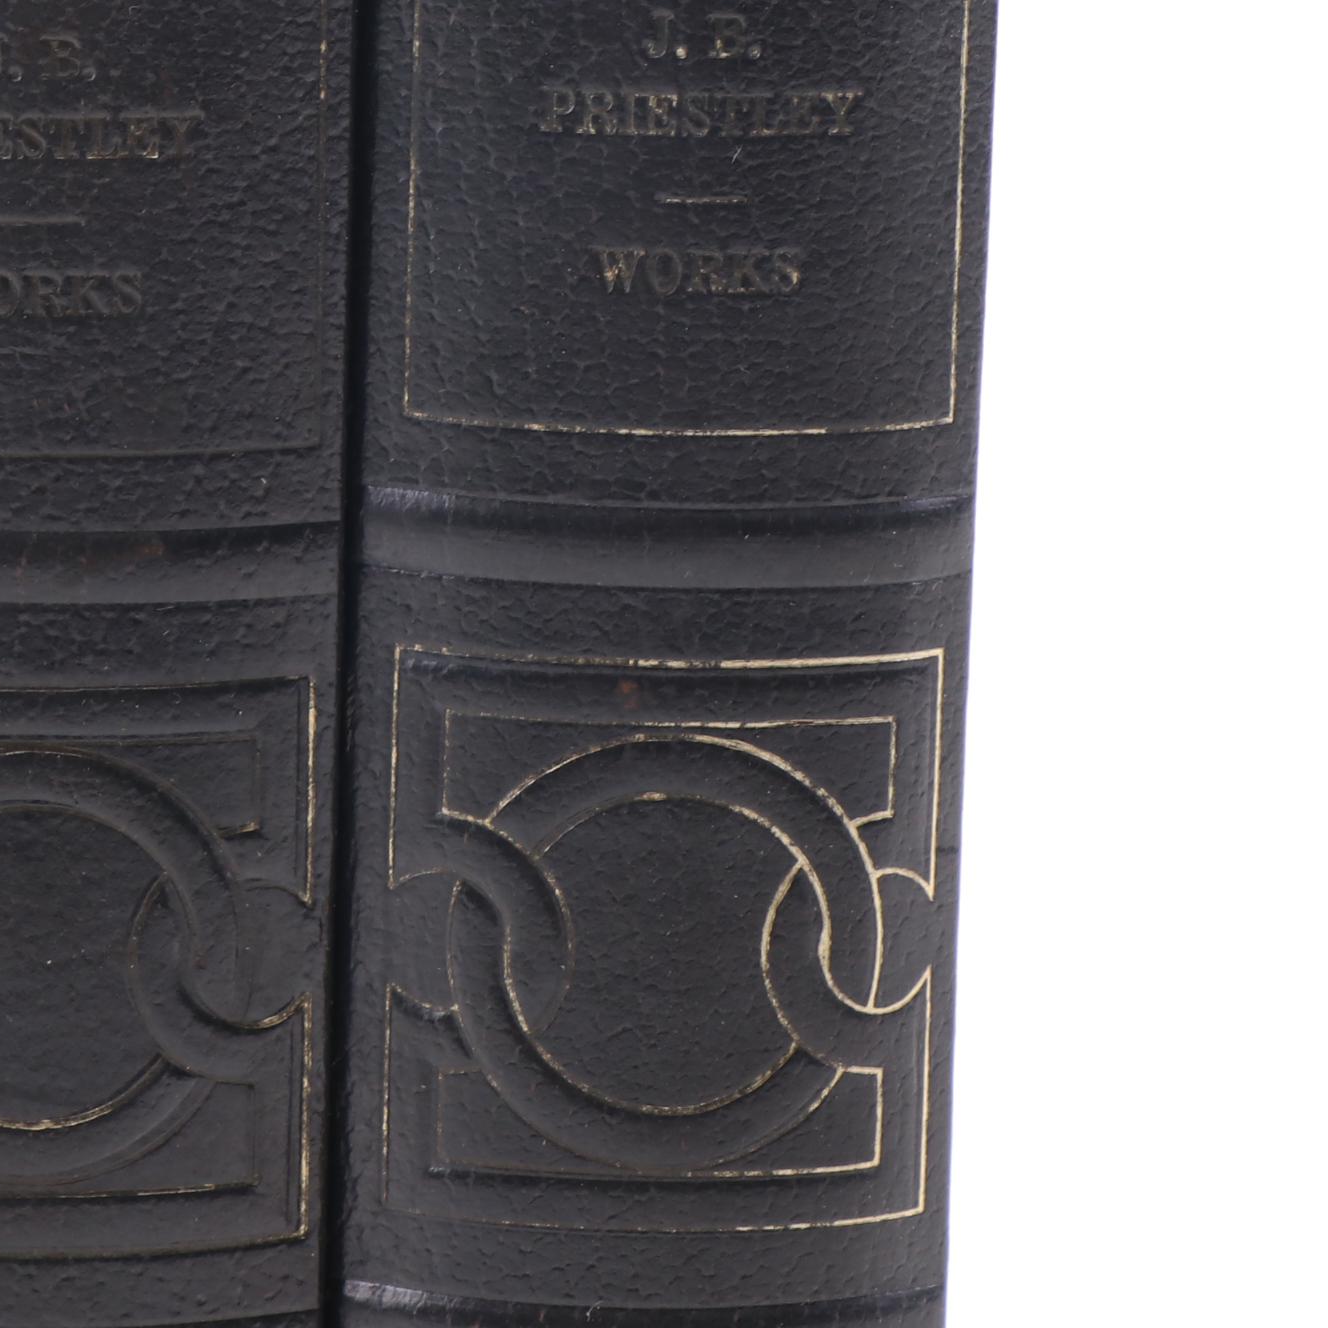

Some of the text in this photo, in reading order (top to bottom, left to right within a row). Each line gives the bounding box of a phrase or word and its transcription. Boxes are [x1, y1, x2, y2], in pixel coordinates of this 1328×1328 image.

[642, 9, 763, 59] J. B.
[539, 86, 865, 137] PRIESTLEY
[588, 246, 801, 296] WORKS
